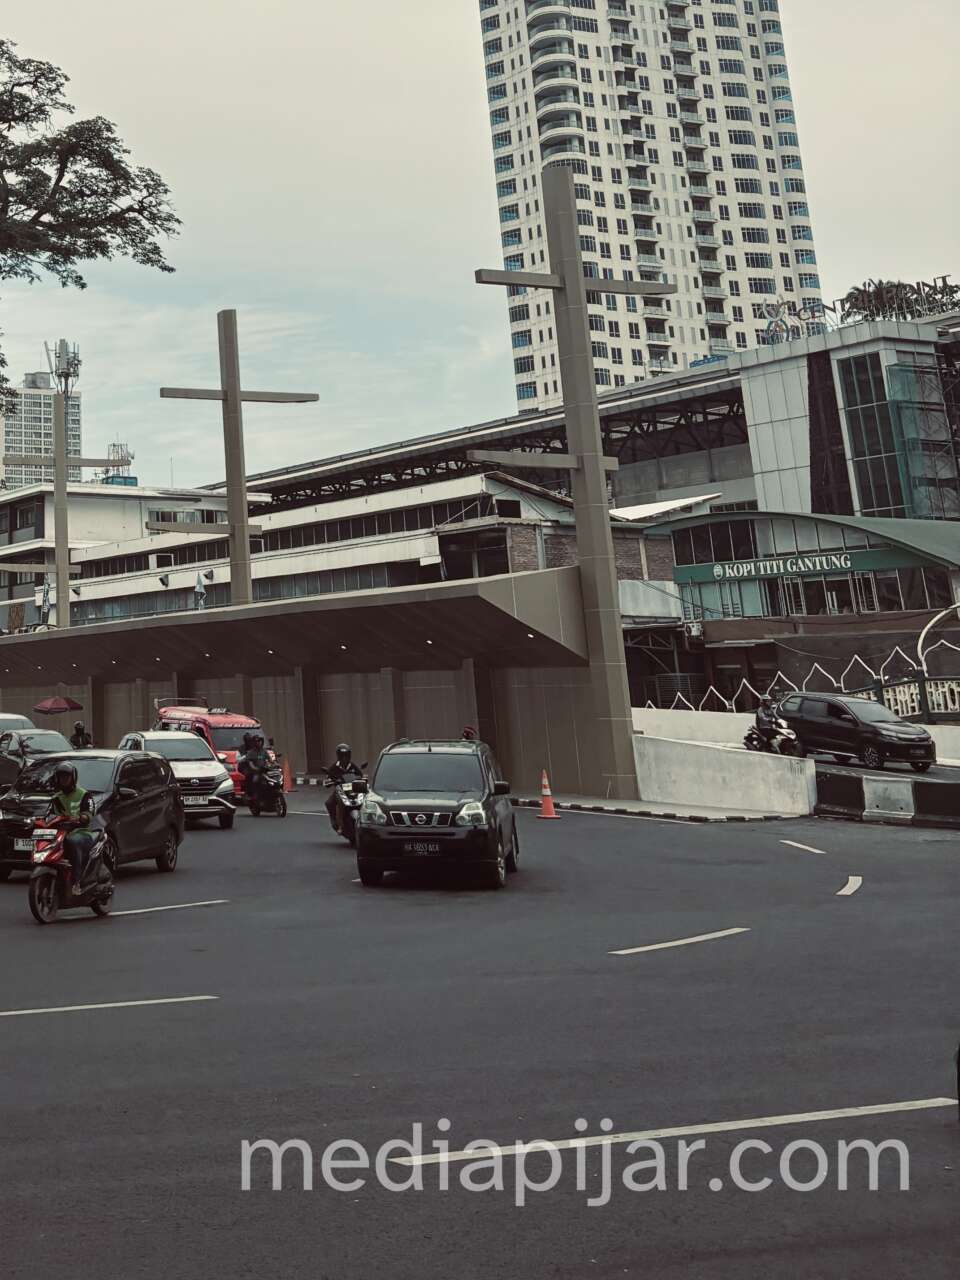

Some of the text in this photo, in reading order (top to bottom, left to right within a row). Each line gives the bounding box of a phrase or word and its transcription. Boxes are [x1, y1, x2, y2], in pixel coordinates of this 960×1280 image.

[724, 554, 851, 578] KOPI TITI GANTUNG
